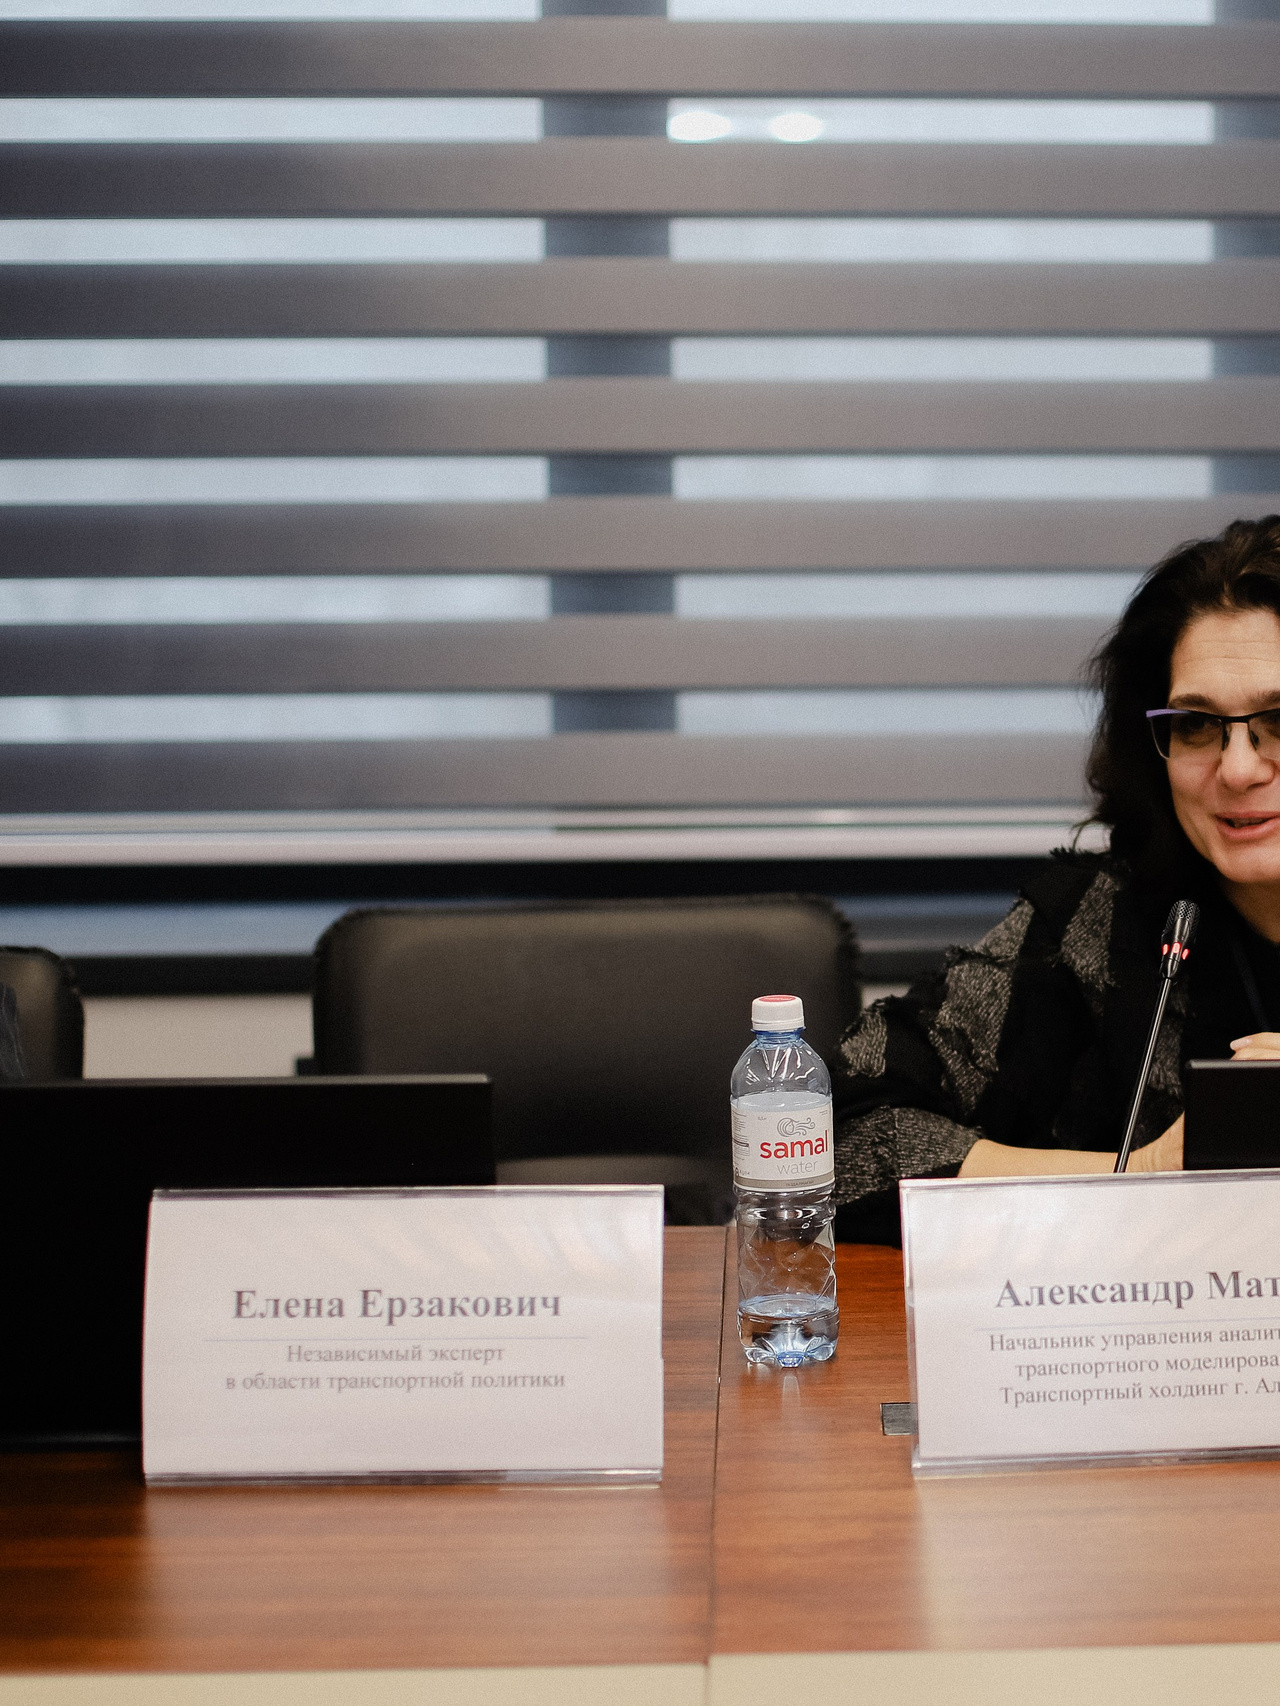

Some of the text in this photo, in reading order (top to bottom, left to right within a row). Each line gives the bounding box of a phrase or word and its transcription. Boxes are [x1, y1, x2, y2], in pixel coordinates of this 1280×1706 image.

[759, 1129, 828, 1159] samal
[776, 1160, 818, 1175] water
[995, 1279, 1194, 1310] Александр
[232, 1289, 561, 1326] Елена Ерзакович
[989, 1333, 1095, 1351] Начальник
[1101, 1330, 1212, 1351] управления
[287, 1344, 504, 1365] Независимый эксперт
[1014, 1358, 1159, 1381] транспортного
[225, 1371, 565, 1393] в области транспортной политики
[999, 1383, 1142, 1408] Транспортный
[1149, 1383, 1229, 1399] холдинг
[1234, 1382, 1248, 1395] г.
